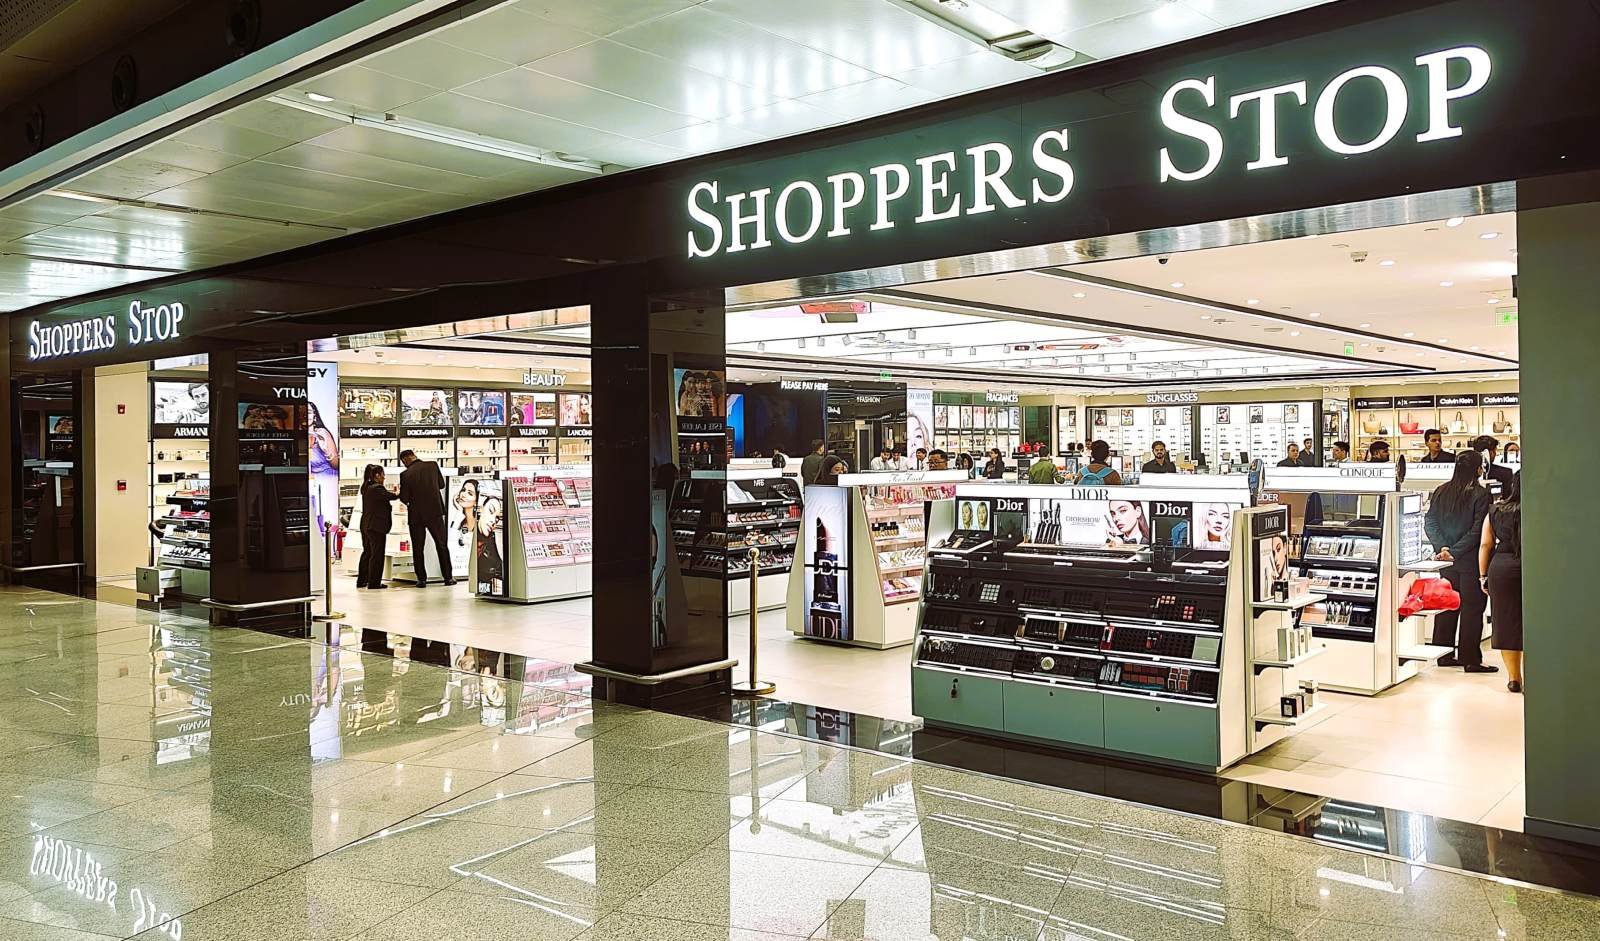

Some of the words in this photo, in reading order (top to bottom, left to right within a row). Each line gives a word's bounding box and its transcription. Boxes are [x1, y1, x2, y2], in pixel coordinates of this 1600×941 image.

[687, 128, 1075, 259] SHOPPERS
[1159, 45, 1493, 184] STOP
[29, 315, 115, 360] SHOPPERS
[129, 300, 184, 345] STOP
[523, 373, 566, 387] BEAUTY
[781, 380, 802, 390] PLEASE
[802, 381, 813, 390] PAY
[814, 382, 829, 391] HERE
[1146, 392, 1198, 403] SUNGLASSES
[470, 428, 495, 436] PRADA
[519, 428, 548, 436] VALENTINO
[1340, 468, 1384, 479] CLINIQUE
[1071, 488, 1109, 500] DIOR
[996, 499, 1024, 511] Dior
[1155, 502, 1188, 516] Dior
[1065, 515, 1101, 523] DIORSHOW
[1264, 516, 1280, 530] DIOR
